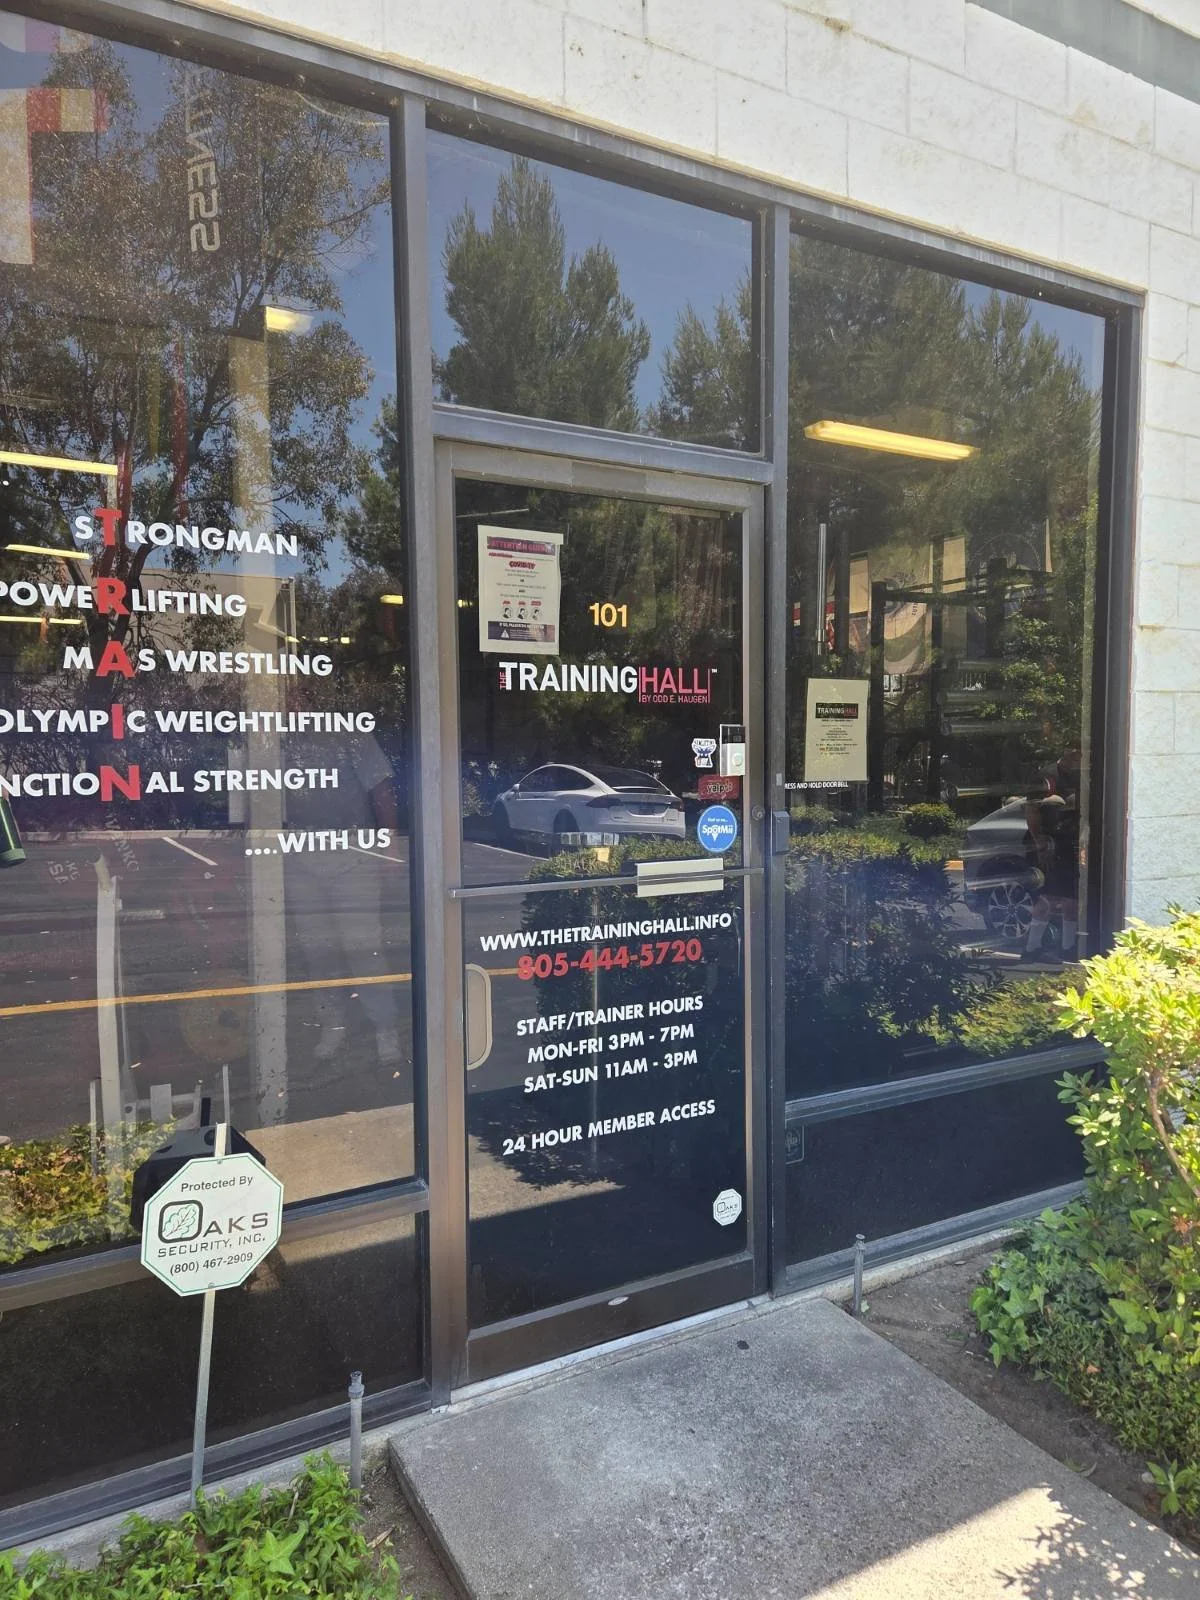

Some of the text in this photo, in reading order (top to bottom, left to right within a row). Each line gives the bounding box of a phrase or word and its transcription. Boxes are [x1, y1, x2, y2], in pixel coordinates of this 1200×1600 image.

[74, 507, 299, 557] STRONGMAN
[589, 602, 629, 628] 101
[62, 640, 334, 679] MAS WRESTLING
[499, 661, 638, 694] TRAINING
[641, 667, 708, 694] HALL
[641, 694, 652, 703] BY
[678, 695, 708, 704] HAUGEN
[817, 706, 845, 715] TRAINING
[0, 703, 376, 741] OLYMPIC WEIGHTLIFTING
[193, 767, 339, 793] STRENGTH
[809, 781, 822, 789] HOLD
[357, 827, 392, 850] US
[480, 913, 732, 952] WWW.THETRAININGHALL.INFO
[516, 938, 703, 981] 805-444-5720
[516, 996, 704, 1036] STAFF/TRAINER HOURS
[527, 1037, 603, 1063] MON-FRI
[608, 1031, 645, 1049] 3PM
[660, 1024, 694, 1042] 7PM
[524, 1066, 598, 1093] SAT-SUN
[605, 1057, 648, 1079] 11AM
[663, 1050, 698, 1069] 3PM
[502, 1099, 716, 1156] 24 HOUR MEMBER ACCESS
[181, 1175, 253, 1193] Protected By
[158, 1233, 265, 1258] SECURITY, INC.
[170, 1252, 253, 1276] (800) 467-2909
